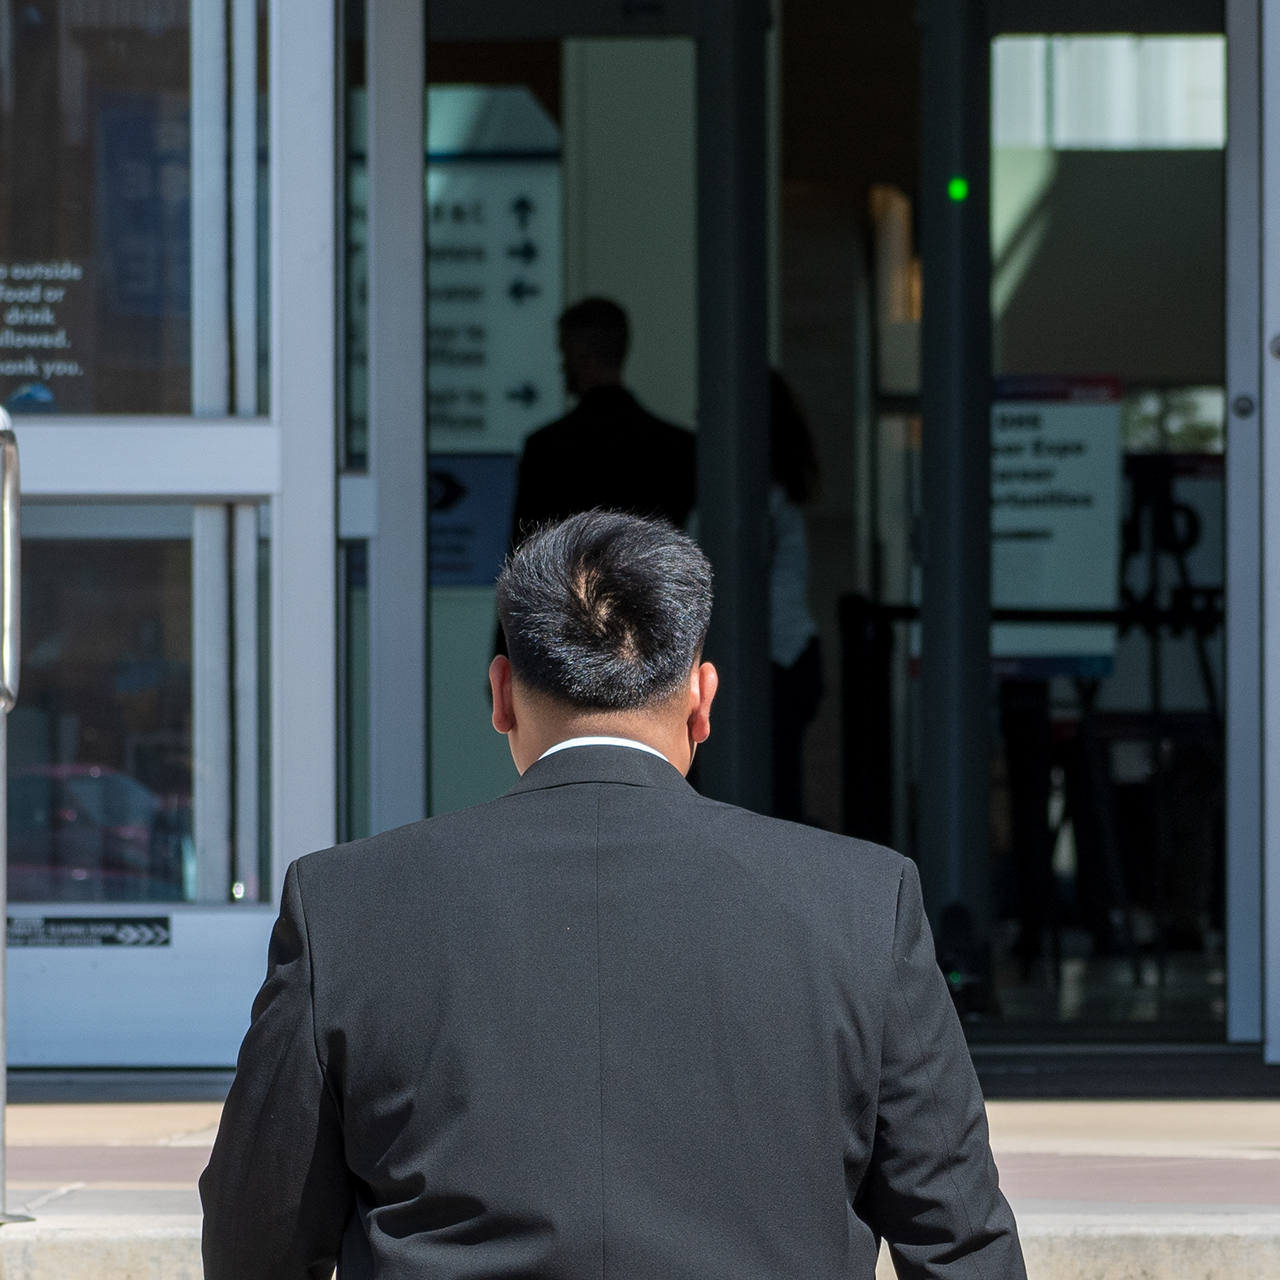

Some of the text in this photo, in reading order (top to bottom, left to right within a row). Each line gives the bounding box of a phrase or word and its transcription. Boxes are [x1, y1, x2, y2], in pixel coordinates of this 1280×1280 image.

[10, 260, 82, 280] outside
[43, 287, 66, 303] or
[4, 304, 55, 326] drink
[41, 361, 84, 381] you.
